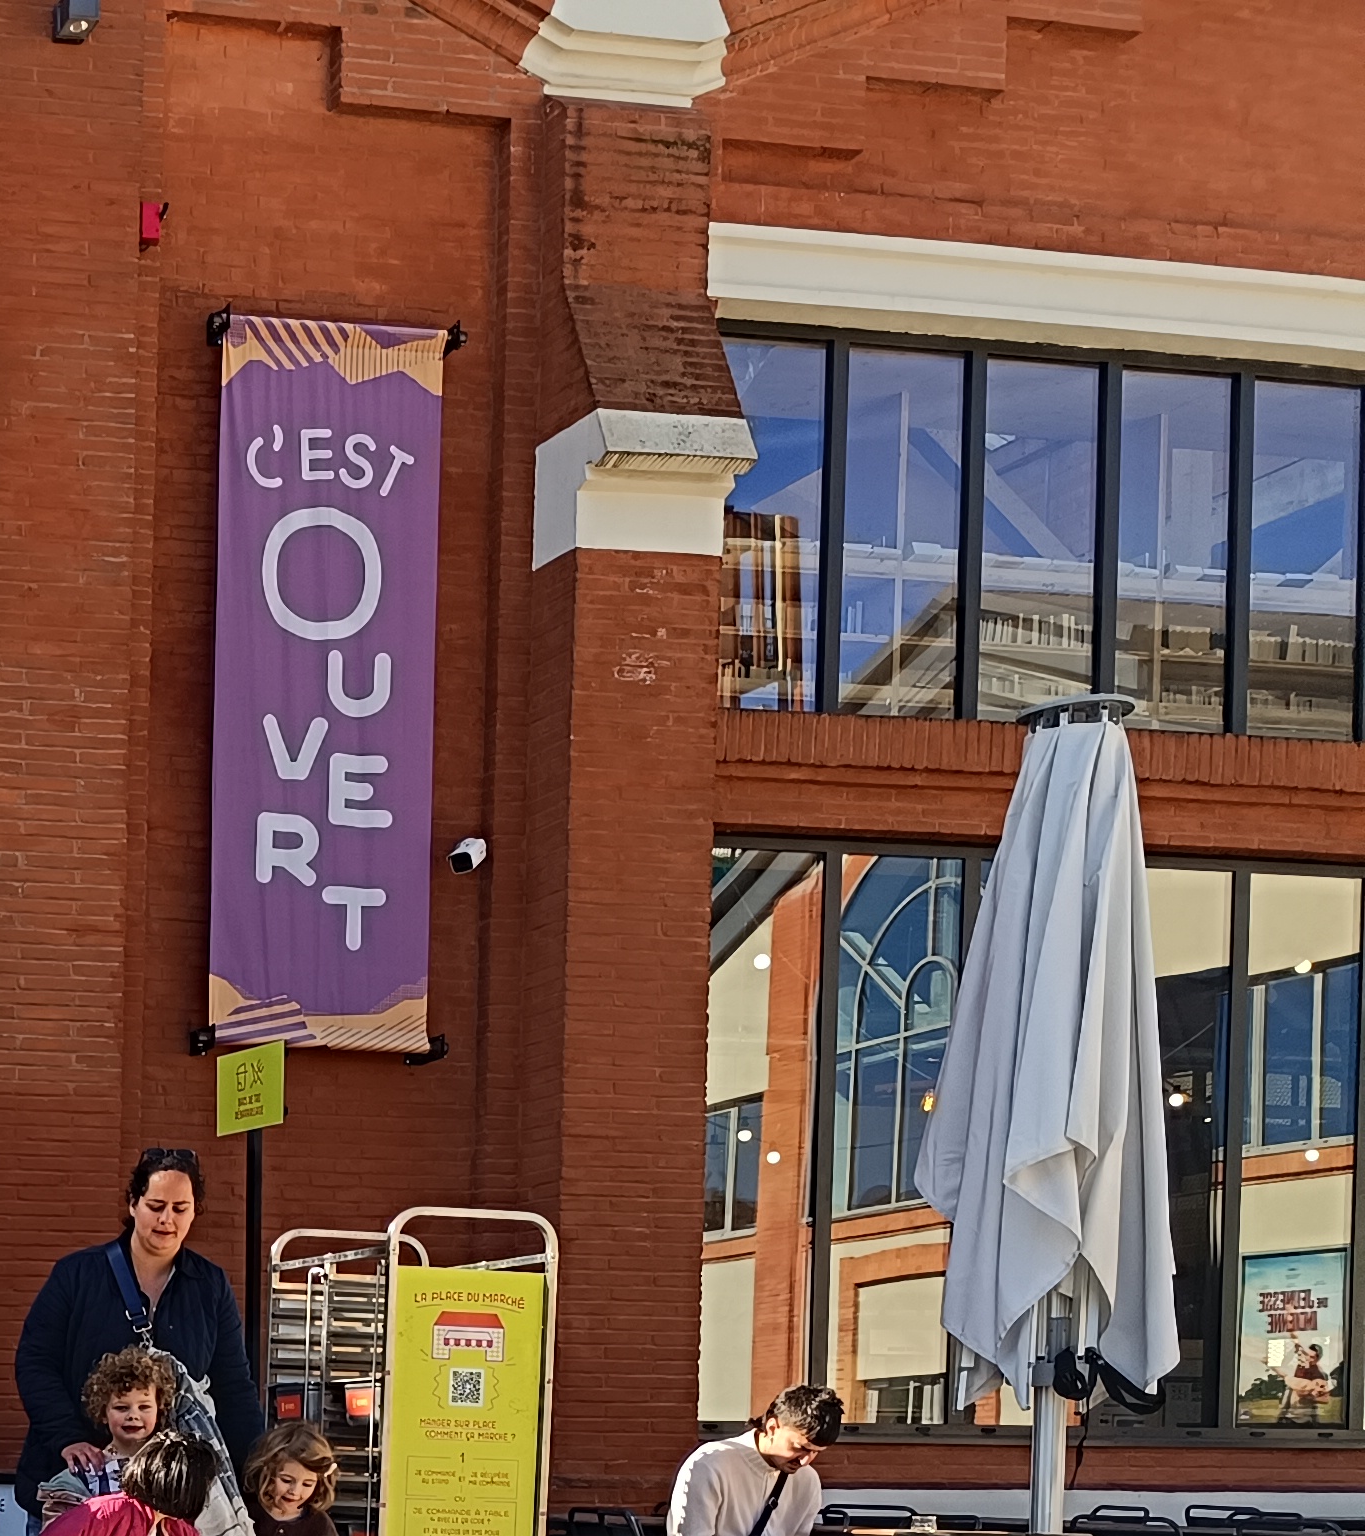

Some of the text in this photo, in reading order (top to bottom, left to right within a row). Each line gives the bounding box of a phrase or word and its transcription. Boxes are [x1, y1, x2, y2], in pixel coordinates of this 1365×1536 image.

[247, 425, 414, 496] C'EST
[414, 1291, 525, 1309] LA PLACE DU MARCHÉ
[420, 1418, 496, 1429] MANGER SUR PLACE
[425, 1430, 463, 1438] COMMENT
[478, 1432, 508, 1441] MARCHE
[459, 1452, 465, 1463] 1
[427, 1508, 471, 1516] COMMANDE
